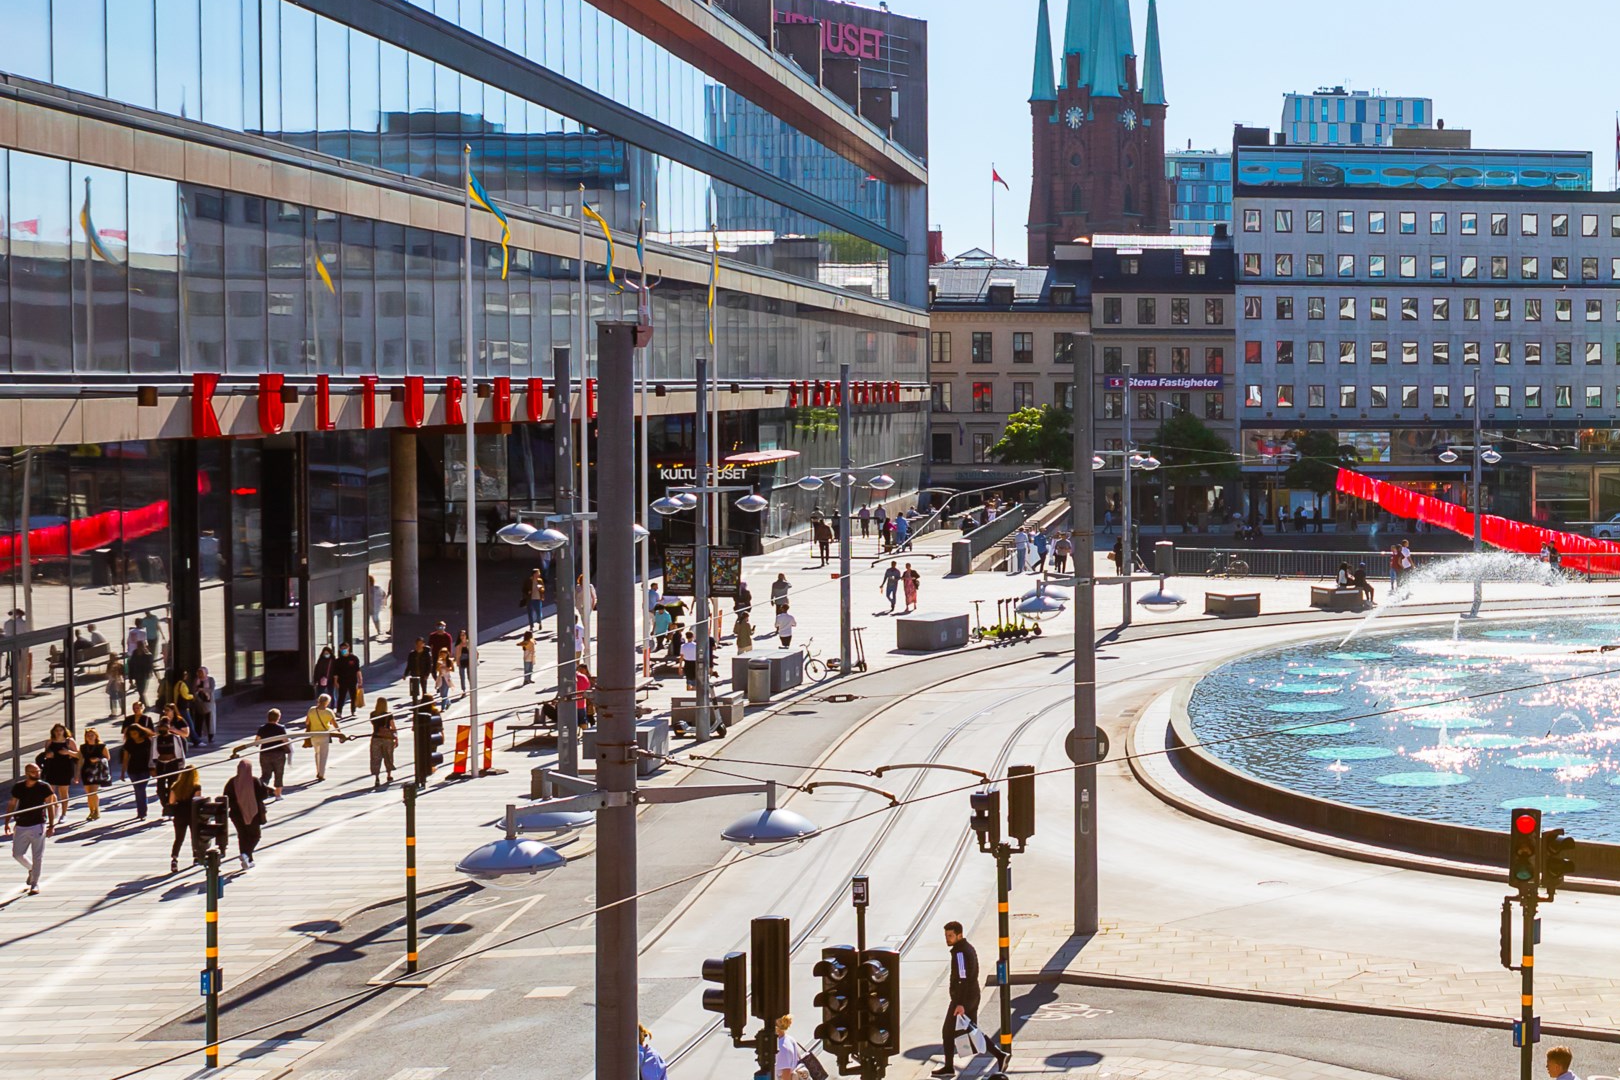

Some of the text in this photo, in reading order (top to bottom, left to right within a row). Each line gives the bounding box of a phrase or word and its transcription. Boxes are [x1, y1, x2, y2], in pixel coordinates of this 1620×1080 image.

[1129, 377, 1157, 387] Stena
[1159, 378, 1218, 388] Fastigheter
[661, 468, 747, 480] KULTUHUSET
